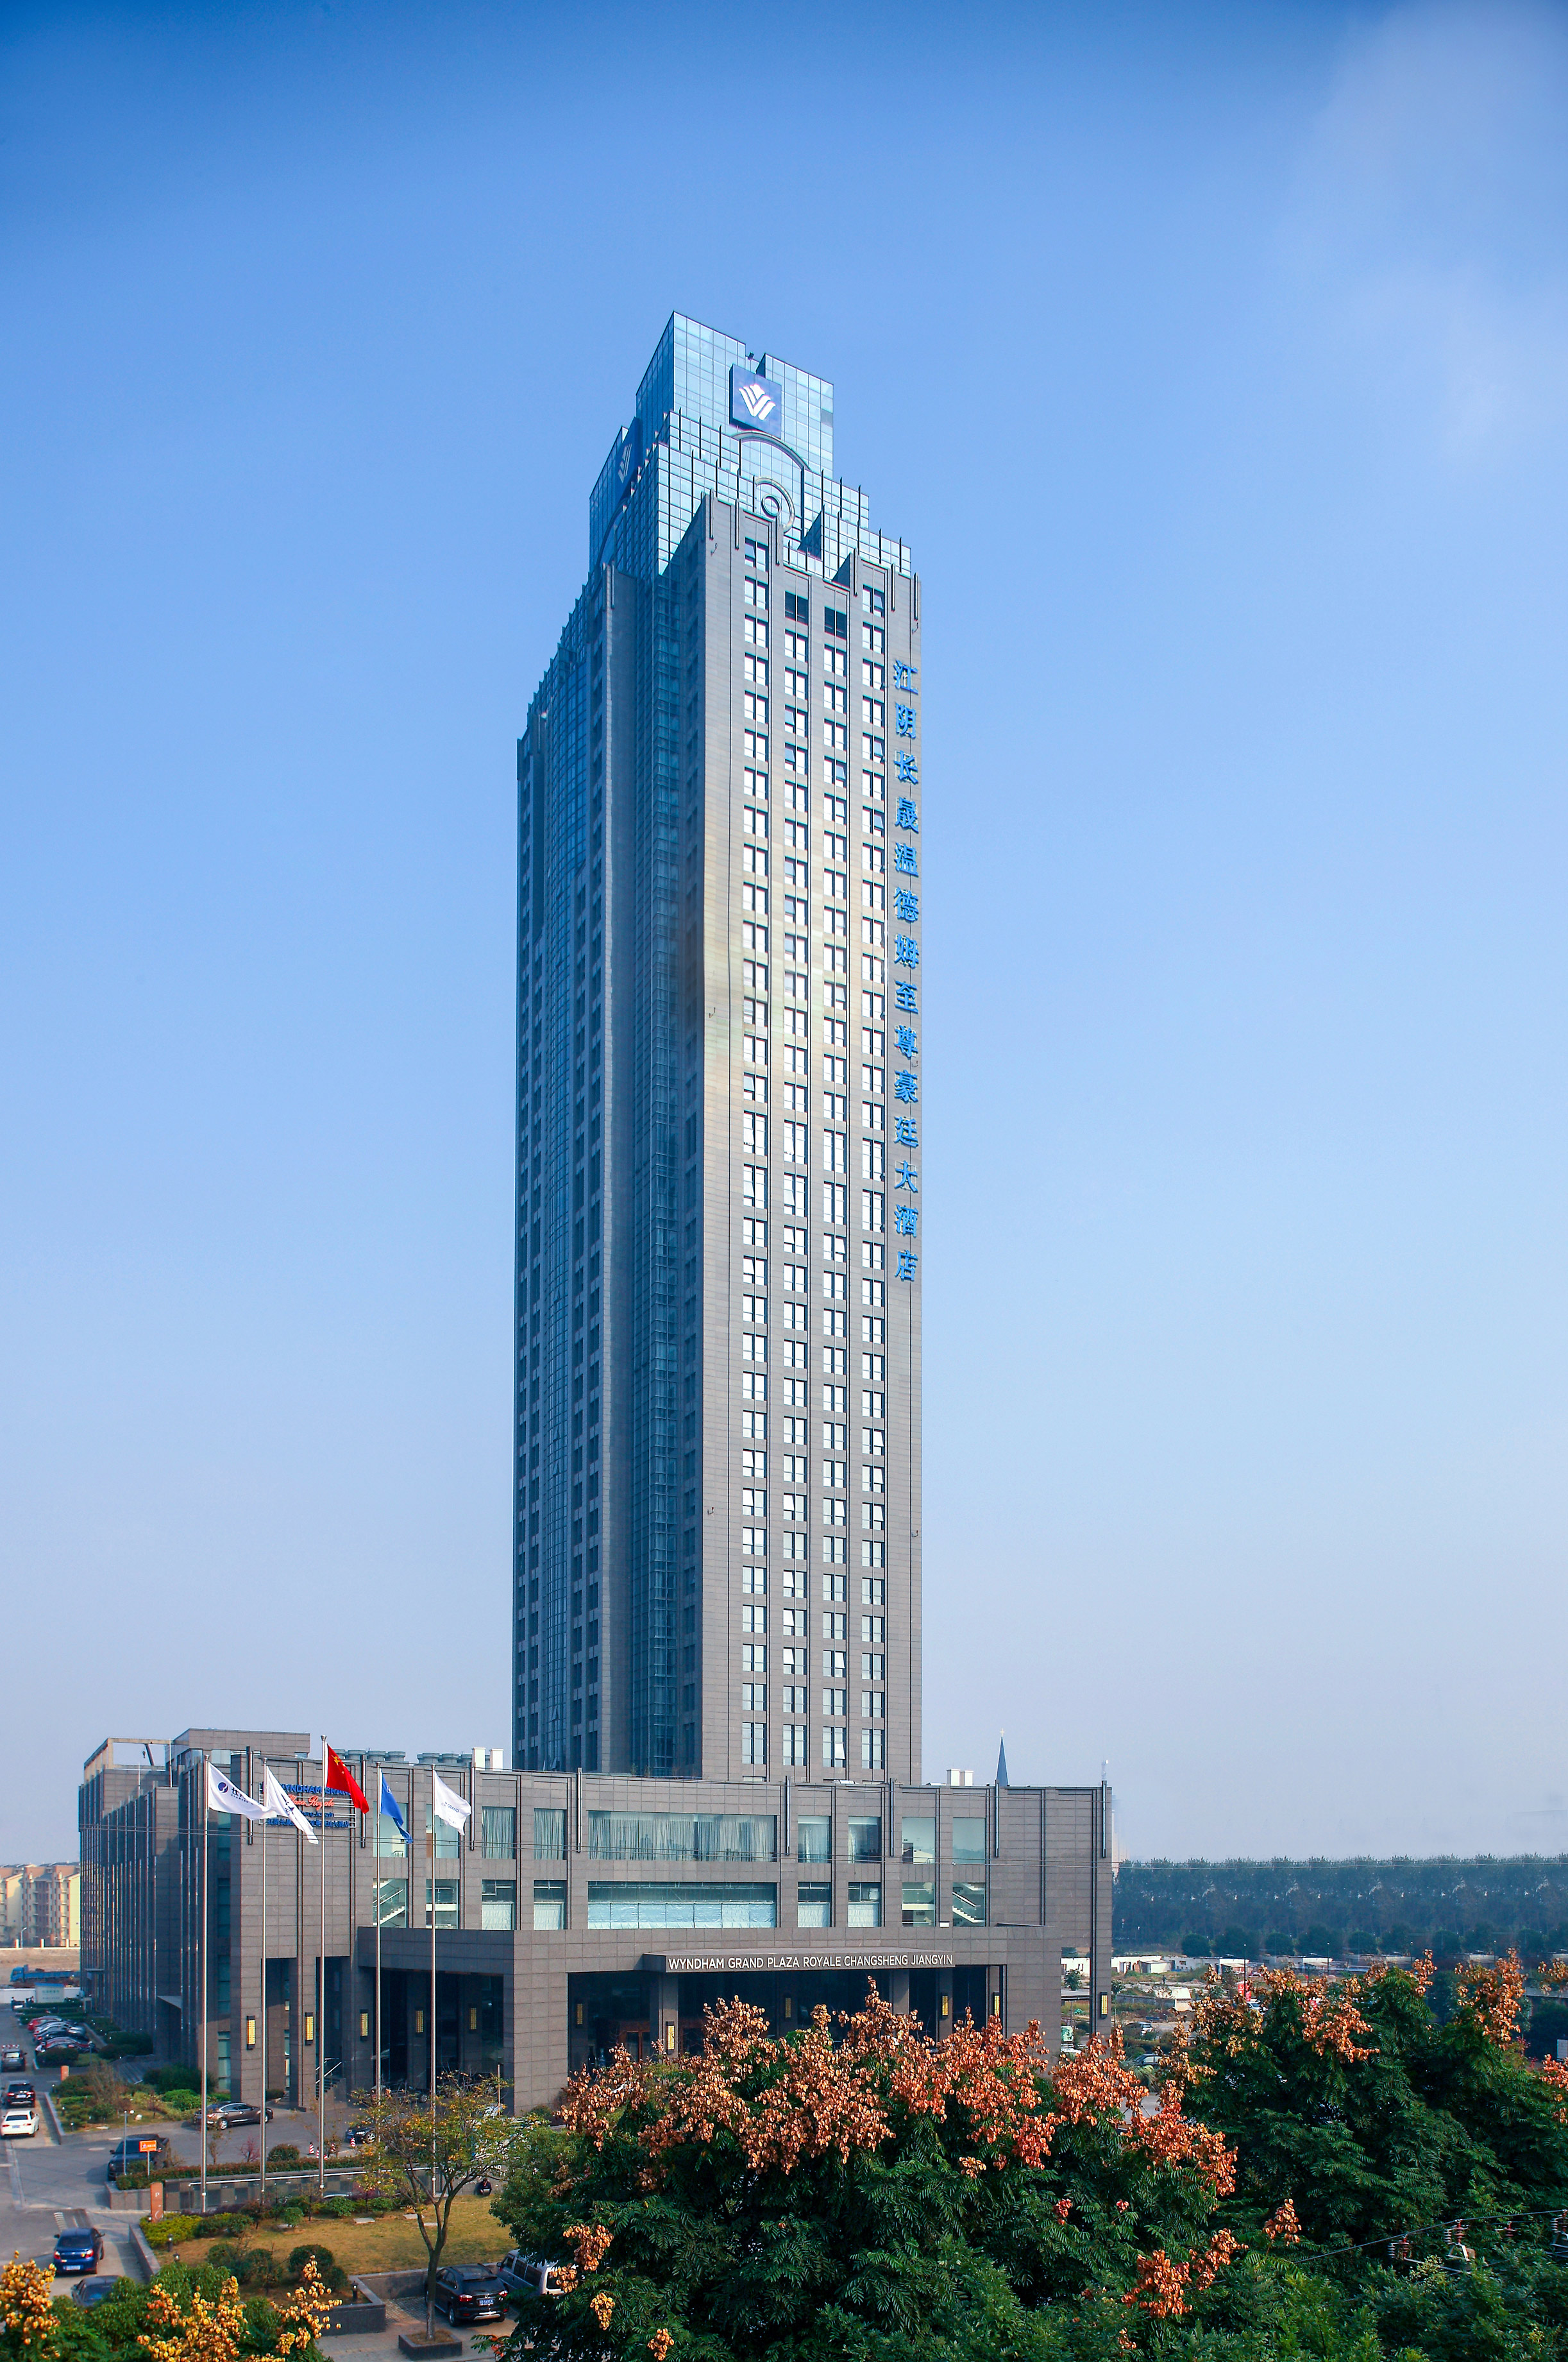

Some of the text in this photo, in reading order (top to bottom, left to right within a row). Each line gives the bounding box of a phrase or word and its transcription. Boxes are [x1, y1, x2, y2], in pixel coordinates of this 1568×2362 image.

[893, 659, 918, 1281] 江阴长晟温德姆至尊豪廷大酒店
[668, 1955, 952, 1969] WYNDHAM GRAND PLAZA ROYALE CHANGSHENG JIANGYIN
